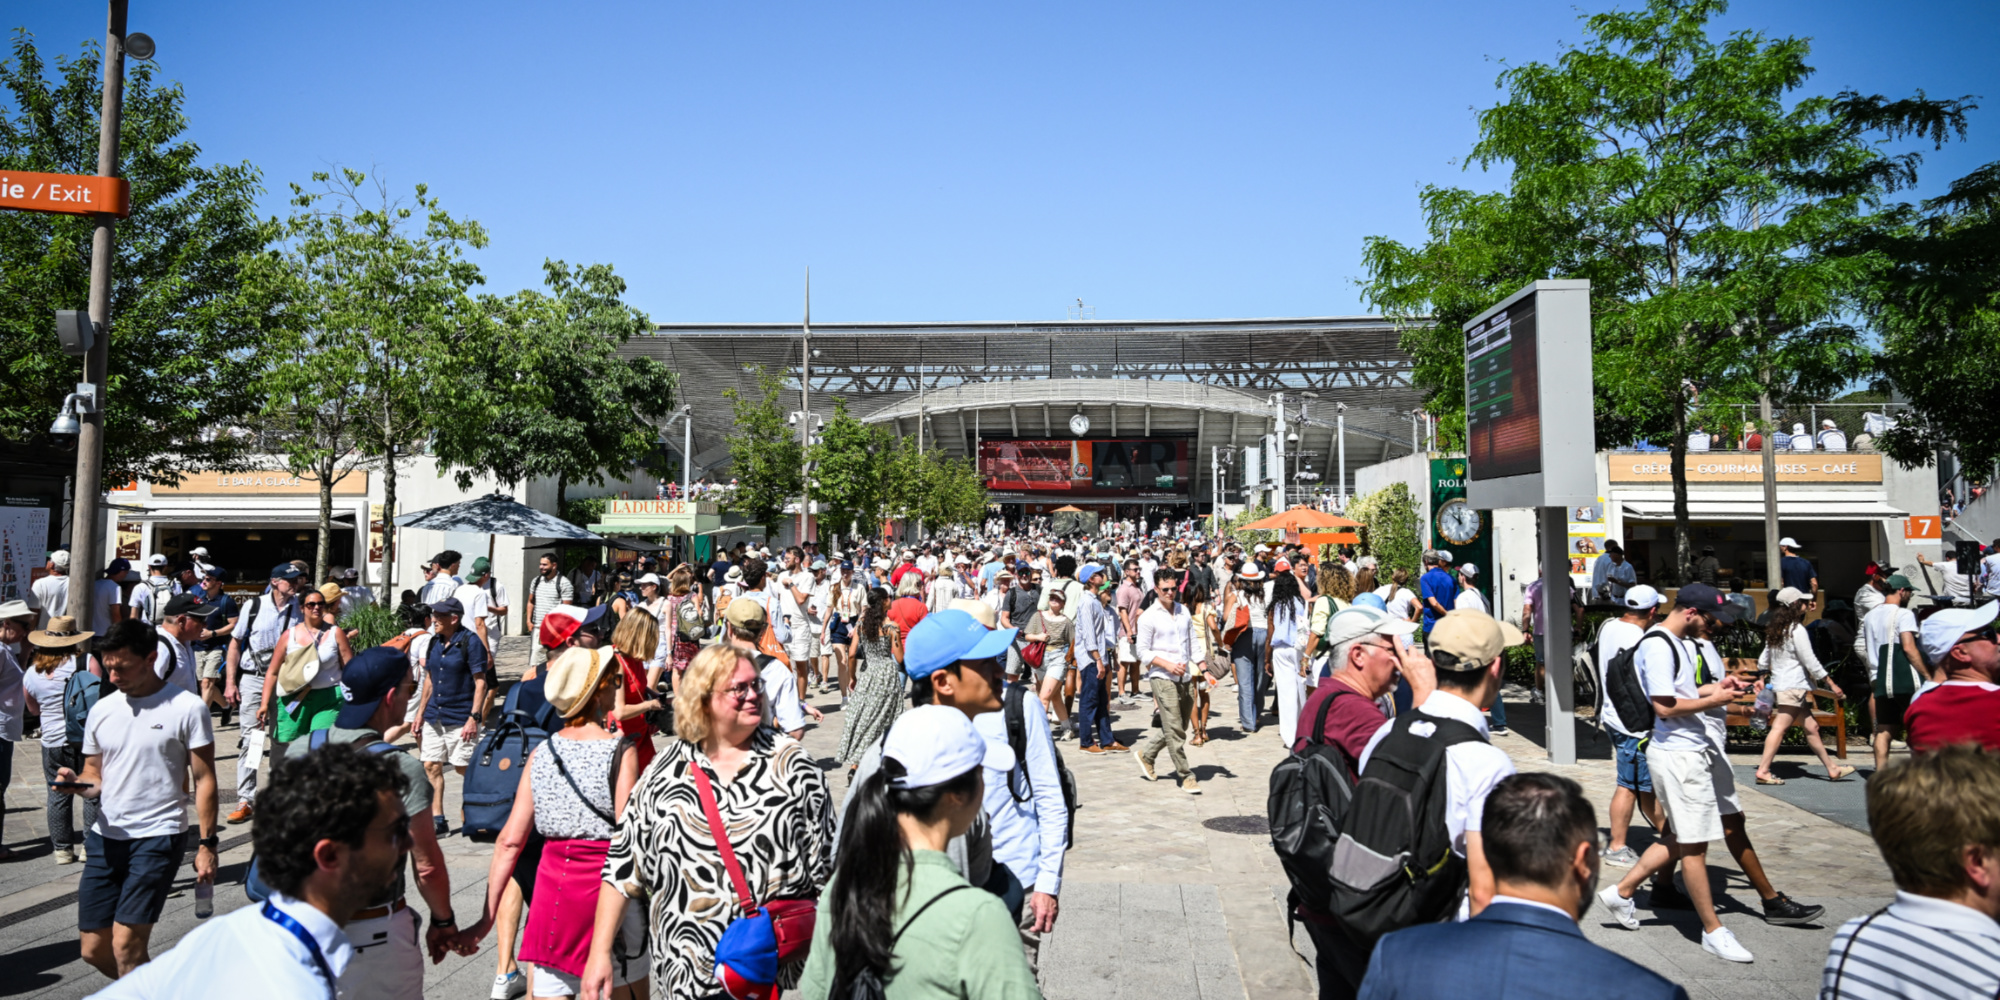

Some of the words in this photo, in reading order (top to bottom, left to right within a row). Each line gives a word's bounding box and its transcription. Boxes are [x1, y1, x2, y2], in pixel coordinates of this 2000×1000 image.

[49, 183, 92, 203] Exit
[1822, 461, 1857, 474] CAFÉ
[217, 476, 229, 486] LE
[232, 476, 253, 486] BAR
[613, 500, 686, 514] LADURÉE
[1918, 519, 1932, 536] 7
